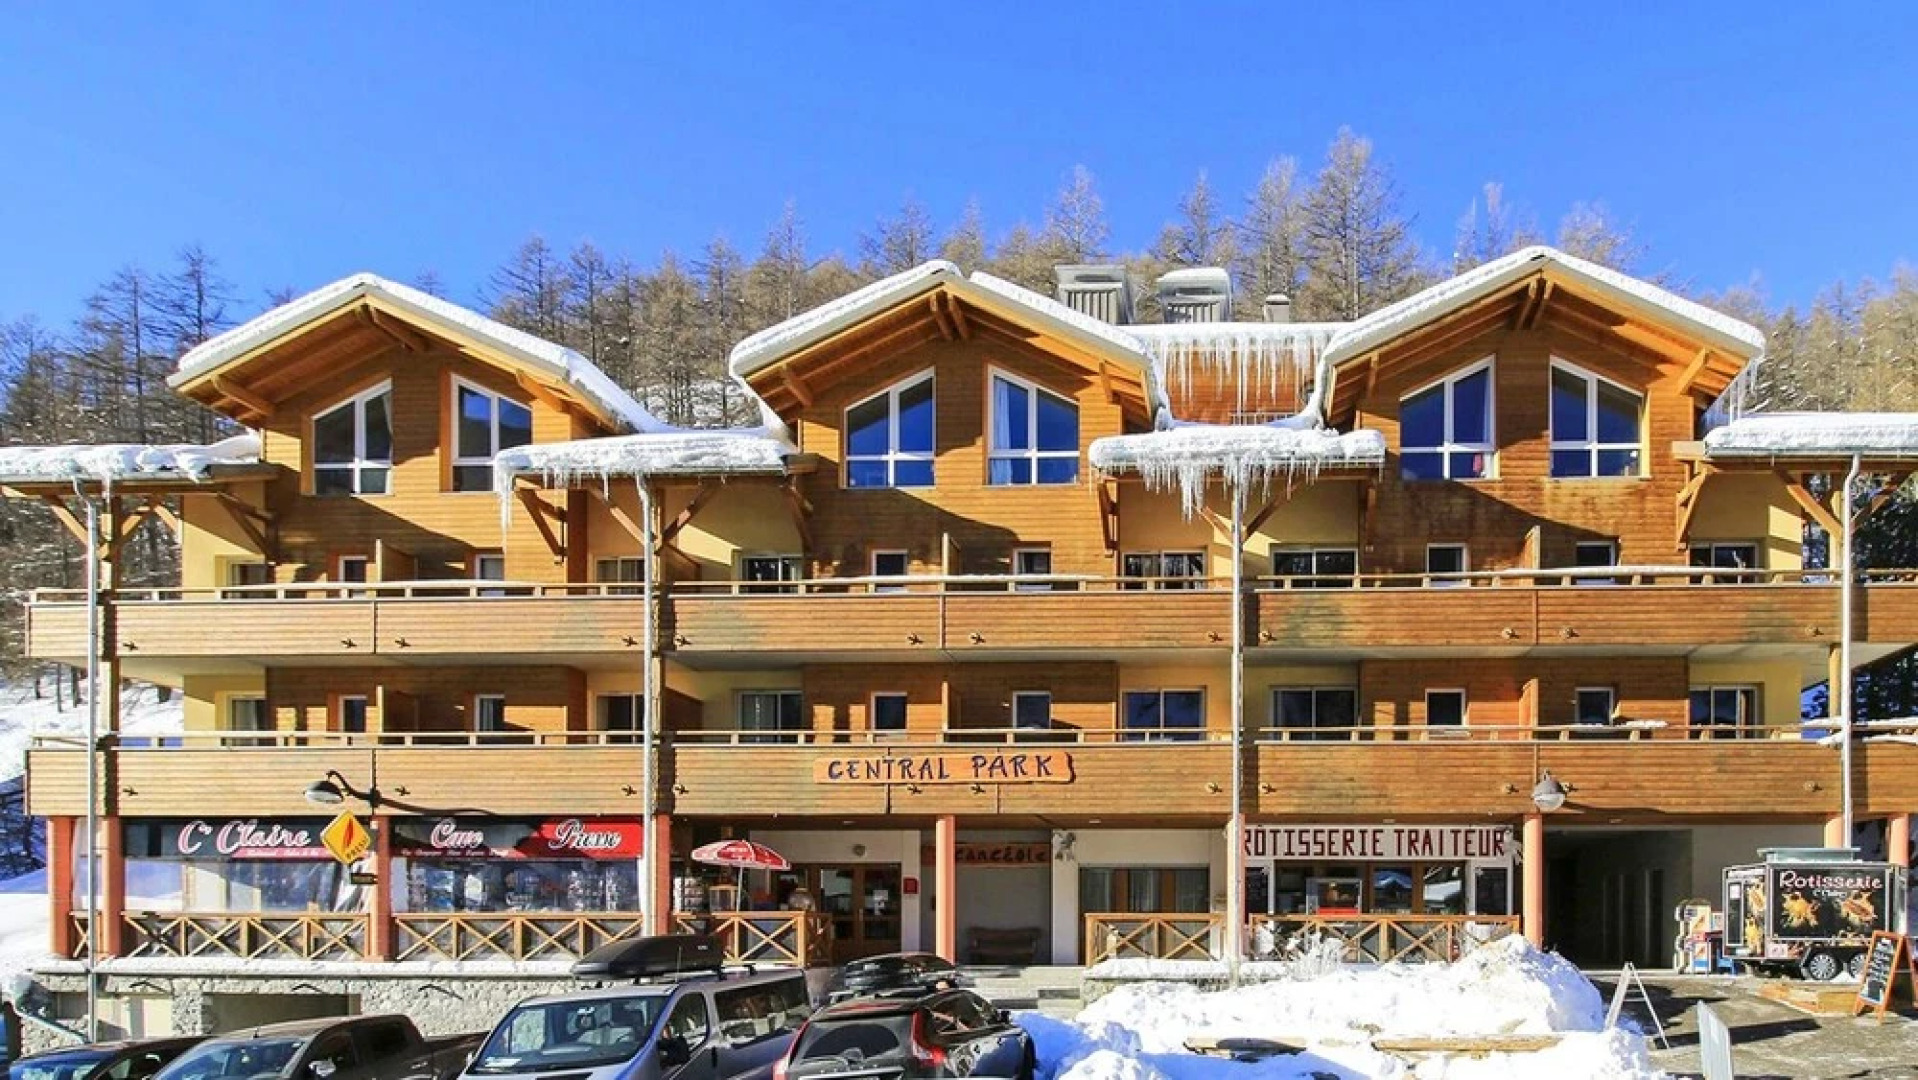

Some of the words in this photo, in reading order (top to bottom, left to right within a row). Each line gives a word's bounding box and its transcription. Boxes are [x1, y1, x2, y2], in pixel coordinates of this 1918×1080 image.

[827, 757, 950, 780] CENTRAL
[971, 754, 1053, 779] PARK
[216, 818, 311, 854] Claire
[548, 818, 622, 849] Presse
[1394, 828, 1505, 857] TRAITEUR
[1779, 870, 1884, 890] Rotisserie
